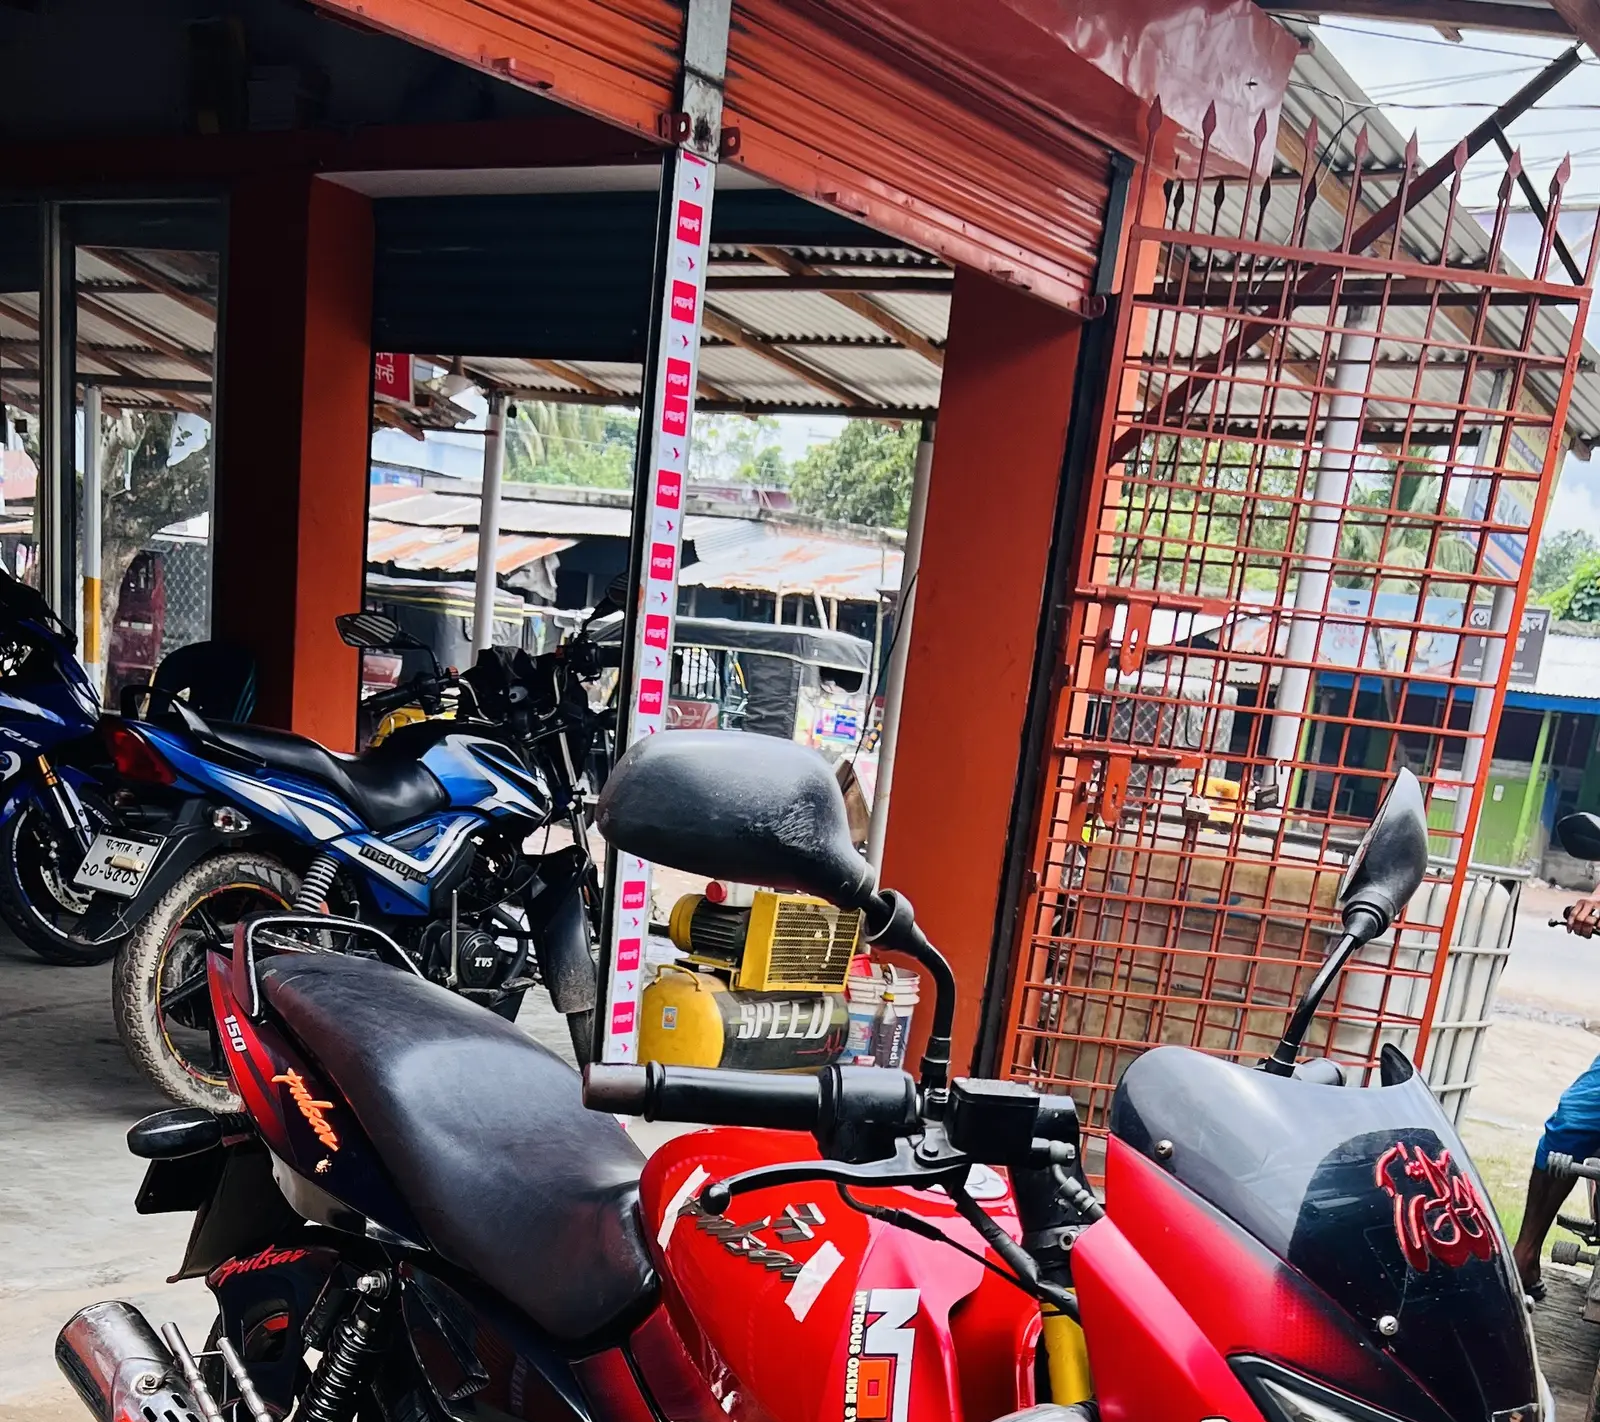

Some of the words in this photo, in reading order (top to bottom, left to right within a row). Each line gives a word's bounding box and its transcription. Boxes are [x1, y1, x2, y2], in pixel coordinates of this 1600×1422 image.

[474, 957, 493, 967] TVS
[224, 1014, 247, 1052] 150
[736, 995, 835, 1039] SPEED
[849, 1290, 868, 1355] NITROUS
[845, 1357, 860, 1404] OXIDE
